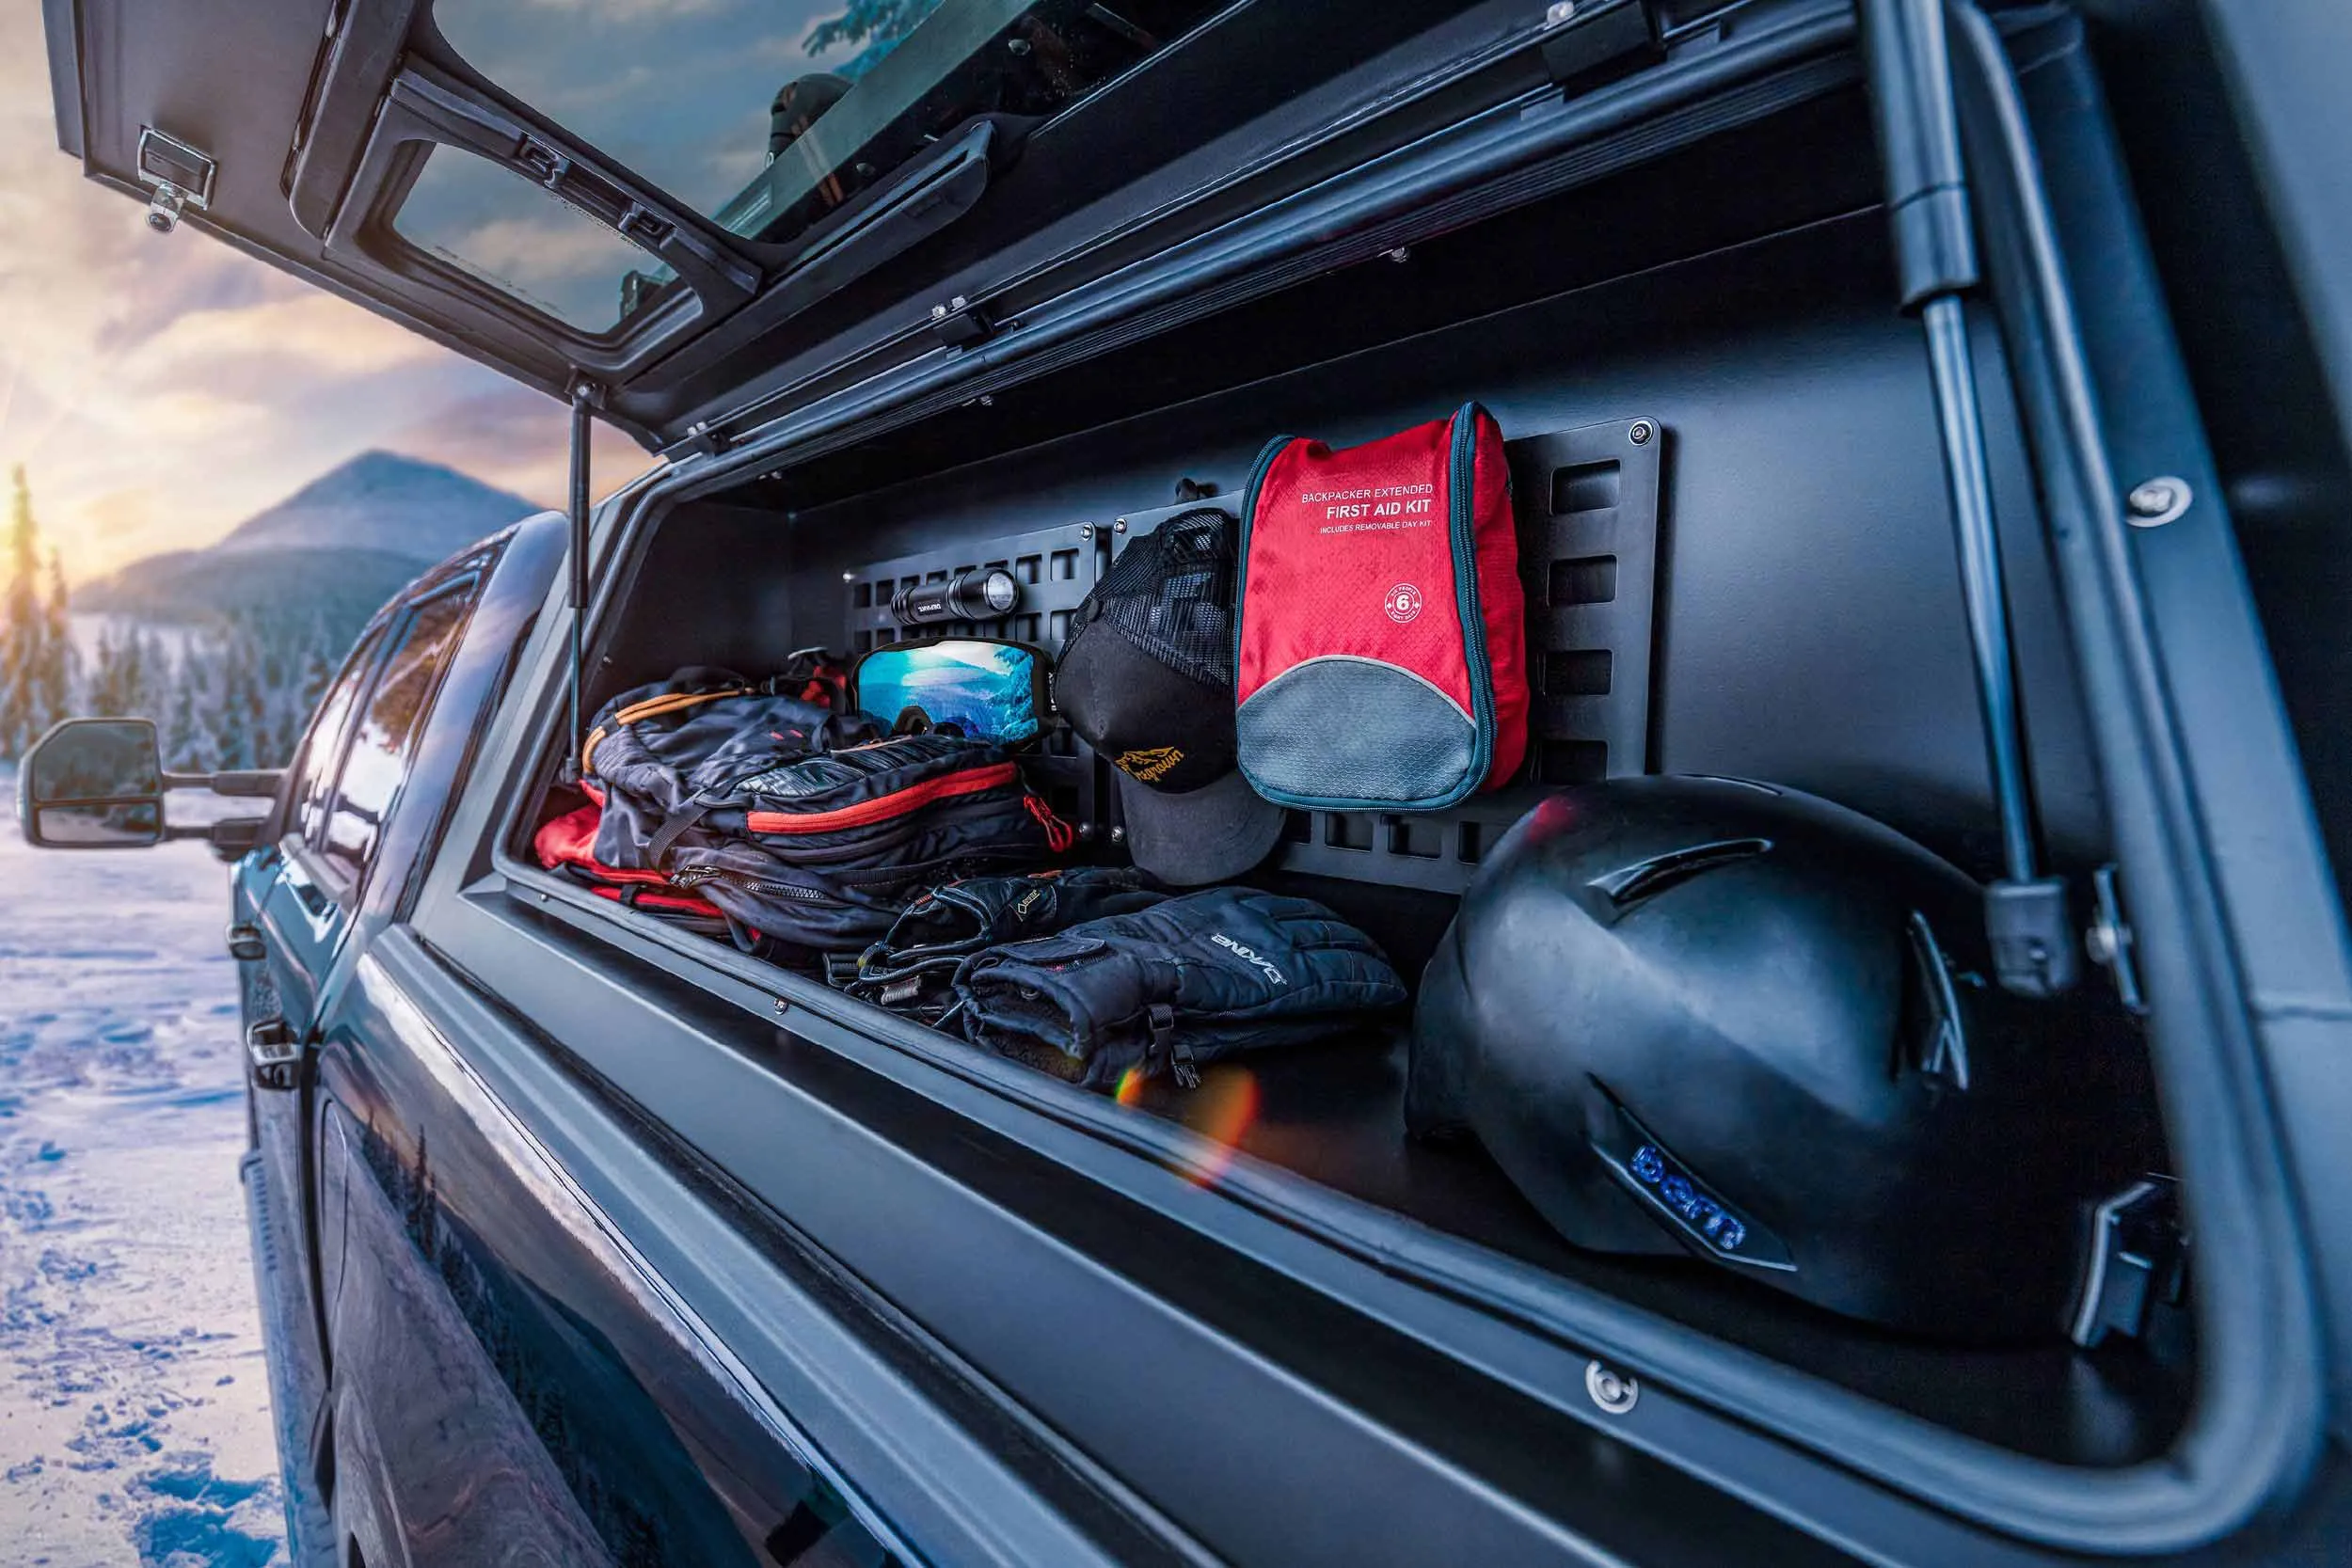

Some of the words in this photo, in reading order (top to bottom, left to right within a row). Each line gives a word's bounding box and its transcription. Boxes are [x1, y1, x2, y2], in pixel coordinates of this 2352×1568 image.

[1302, 488, 1371, 504] BACKPACKER
[1375, 483, 1433, 498] EXTENDED
[1327, 503, 1370, 519] FIRST
[1374, 501, 1401, 516] AID
[1406, 499, 1431, 514] KIT
[1320, 524, 1354, 534] INCLUDES
[1355, 521, 1400, 531] REMOVABLE
[1402, 520, 1417, 529] DAY
[1419, 519, 1431, 528] KIT
[1396, 594, 1409, 610] 6
[1211, 932, 1281, 985] DAKINE
